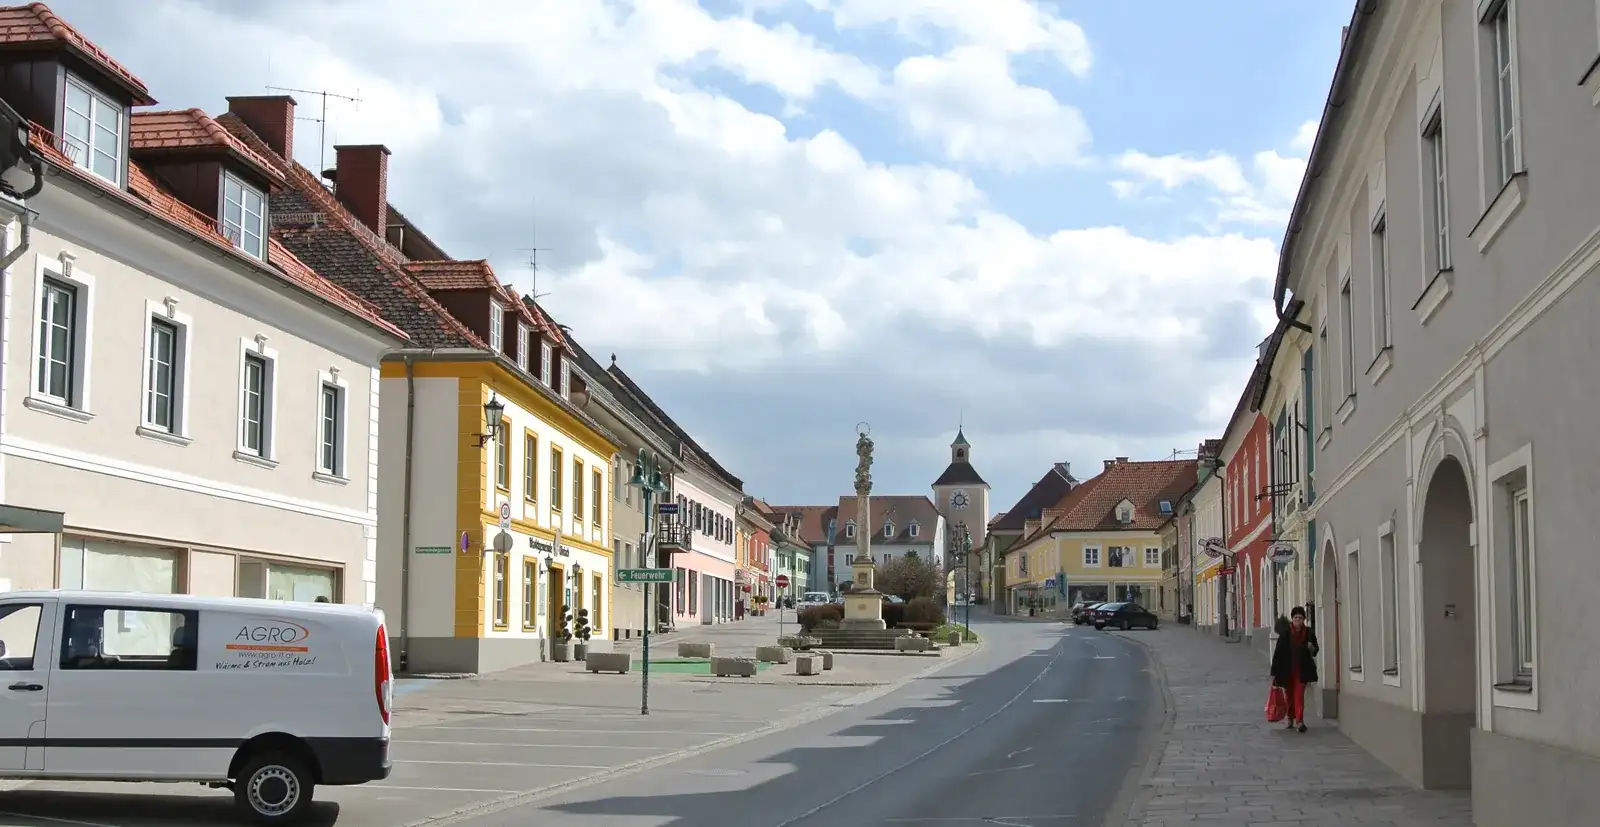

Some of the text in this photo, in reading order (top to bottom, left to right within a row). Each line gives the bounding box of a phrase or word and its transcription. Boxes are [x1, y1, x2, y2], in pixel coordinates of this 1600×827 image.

[630, 570, 665, 580] Feuerwehr
[235, 626, 296, 643] AGRO
[215, 660, 241, 670] Wärme
[243, 660, 250, 668] &
[252, 659, 277, 668] Strom
[292, 656, 317, 667] Holz!
